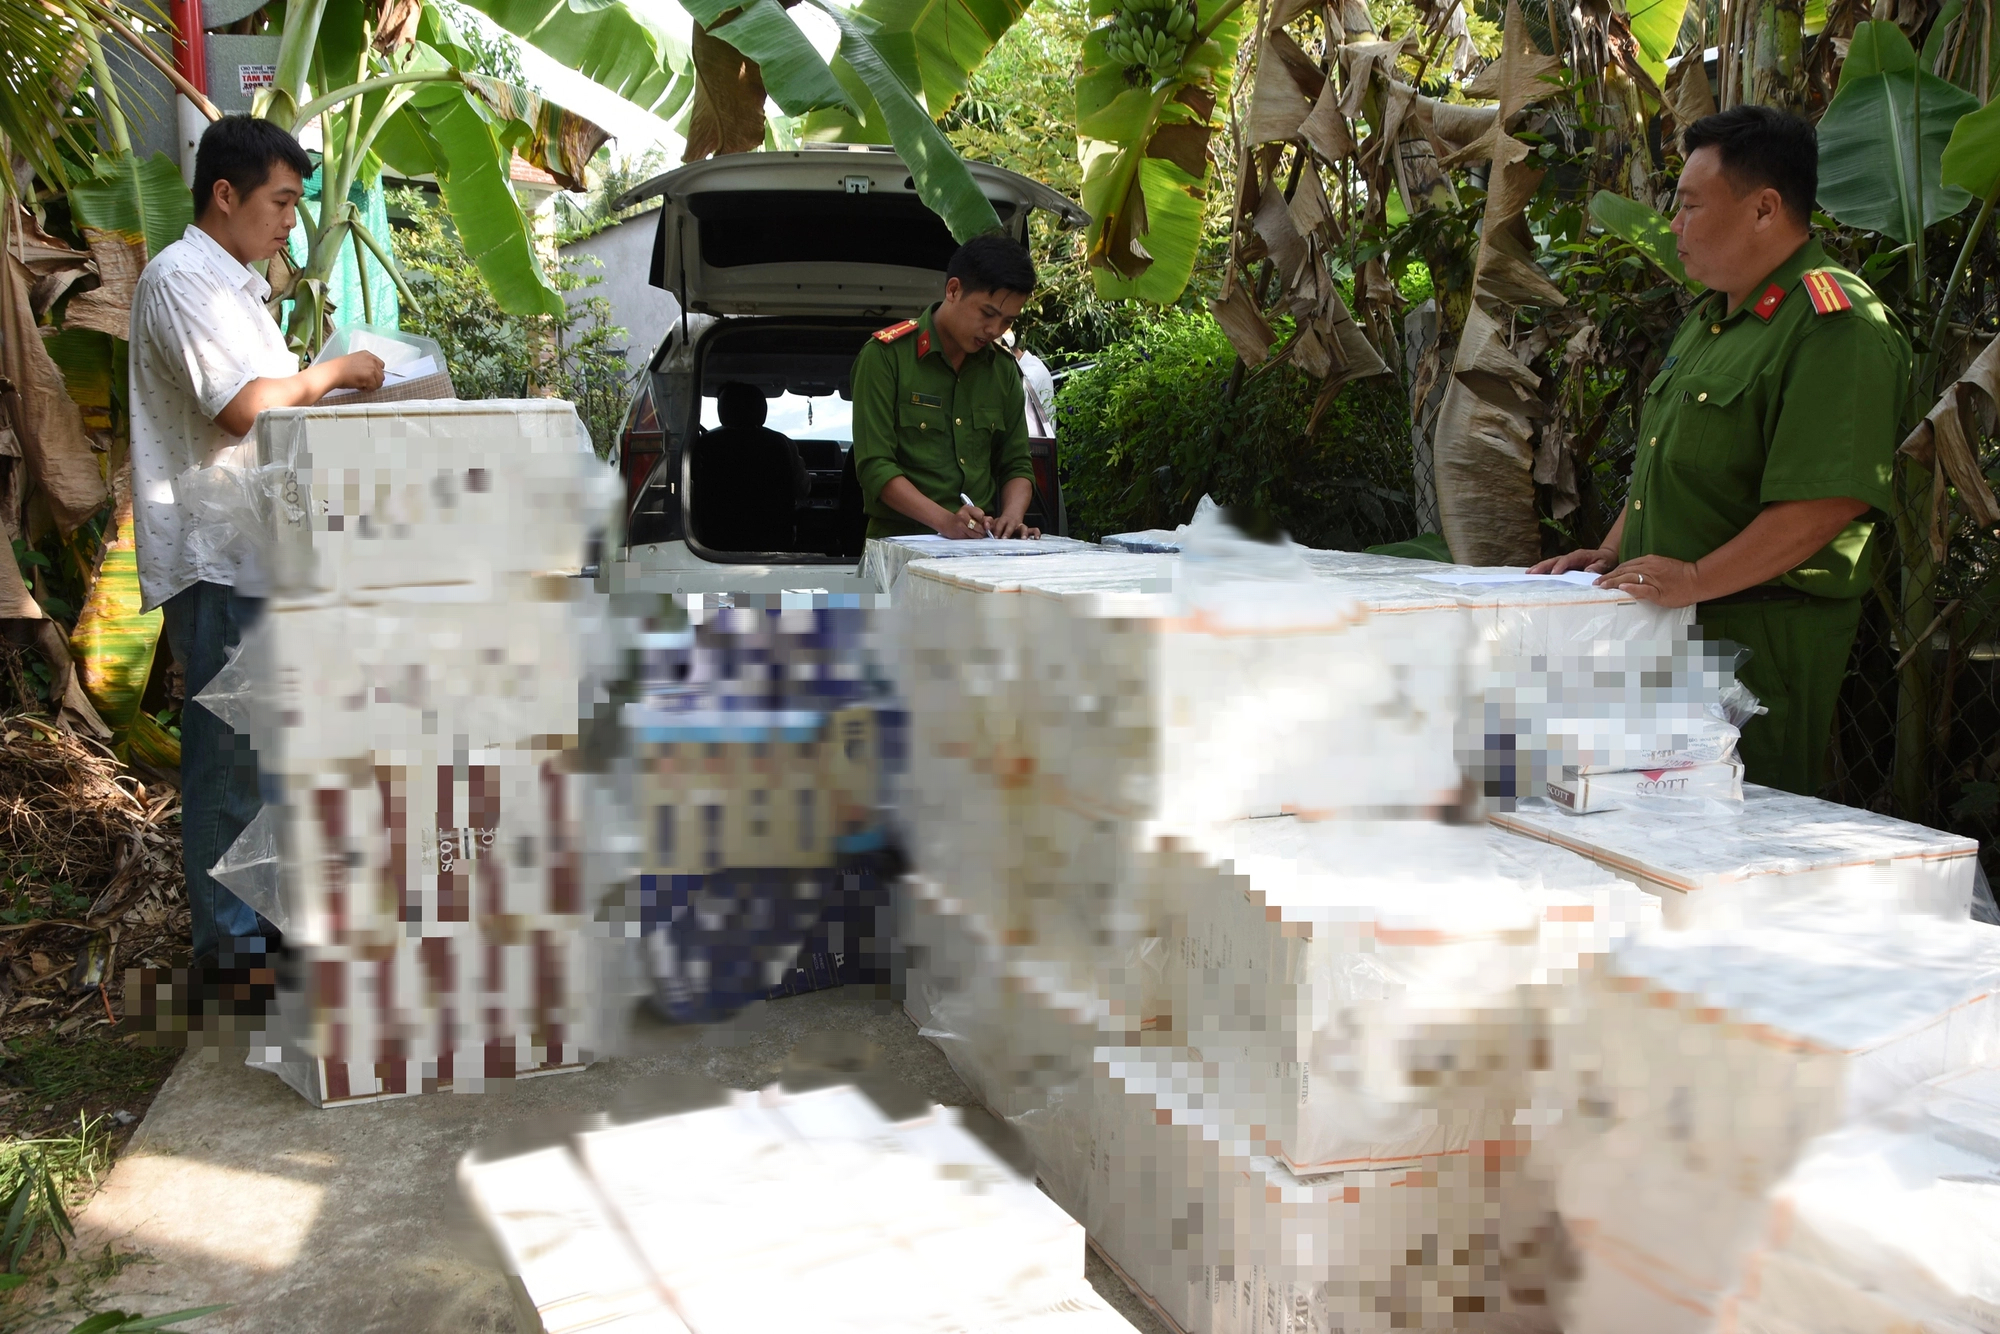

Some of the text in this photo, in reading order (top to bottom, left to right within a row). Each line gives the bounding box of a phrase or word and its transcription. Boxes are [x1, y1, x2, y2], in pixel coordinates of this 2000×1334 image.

[285, 471, 301, 528] SCOTT
[1547, 784, 1570, 801] SCOTT
[1635, 778, 1689, 797] SCOTT
[438, 828, 454, 872] SCOT
[1301, 1062, 1309, 1105] IGARETTES
